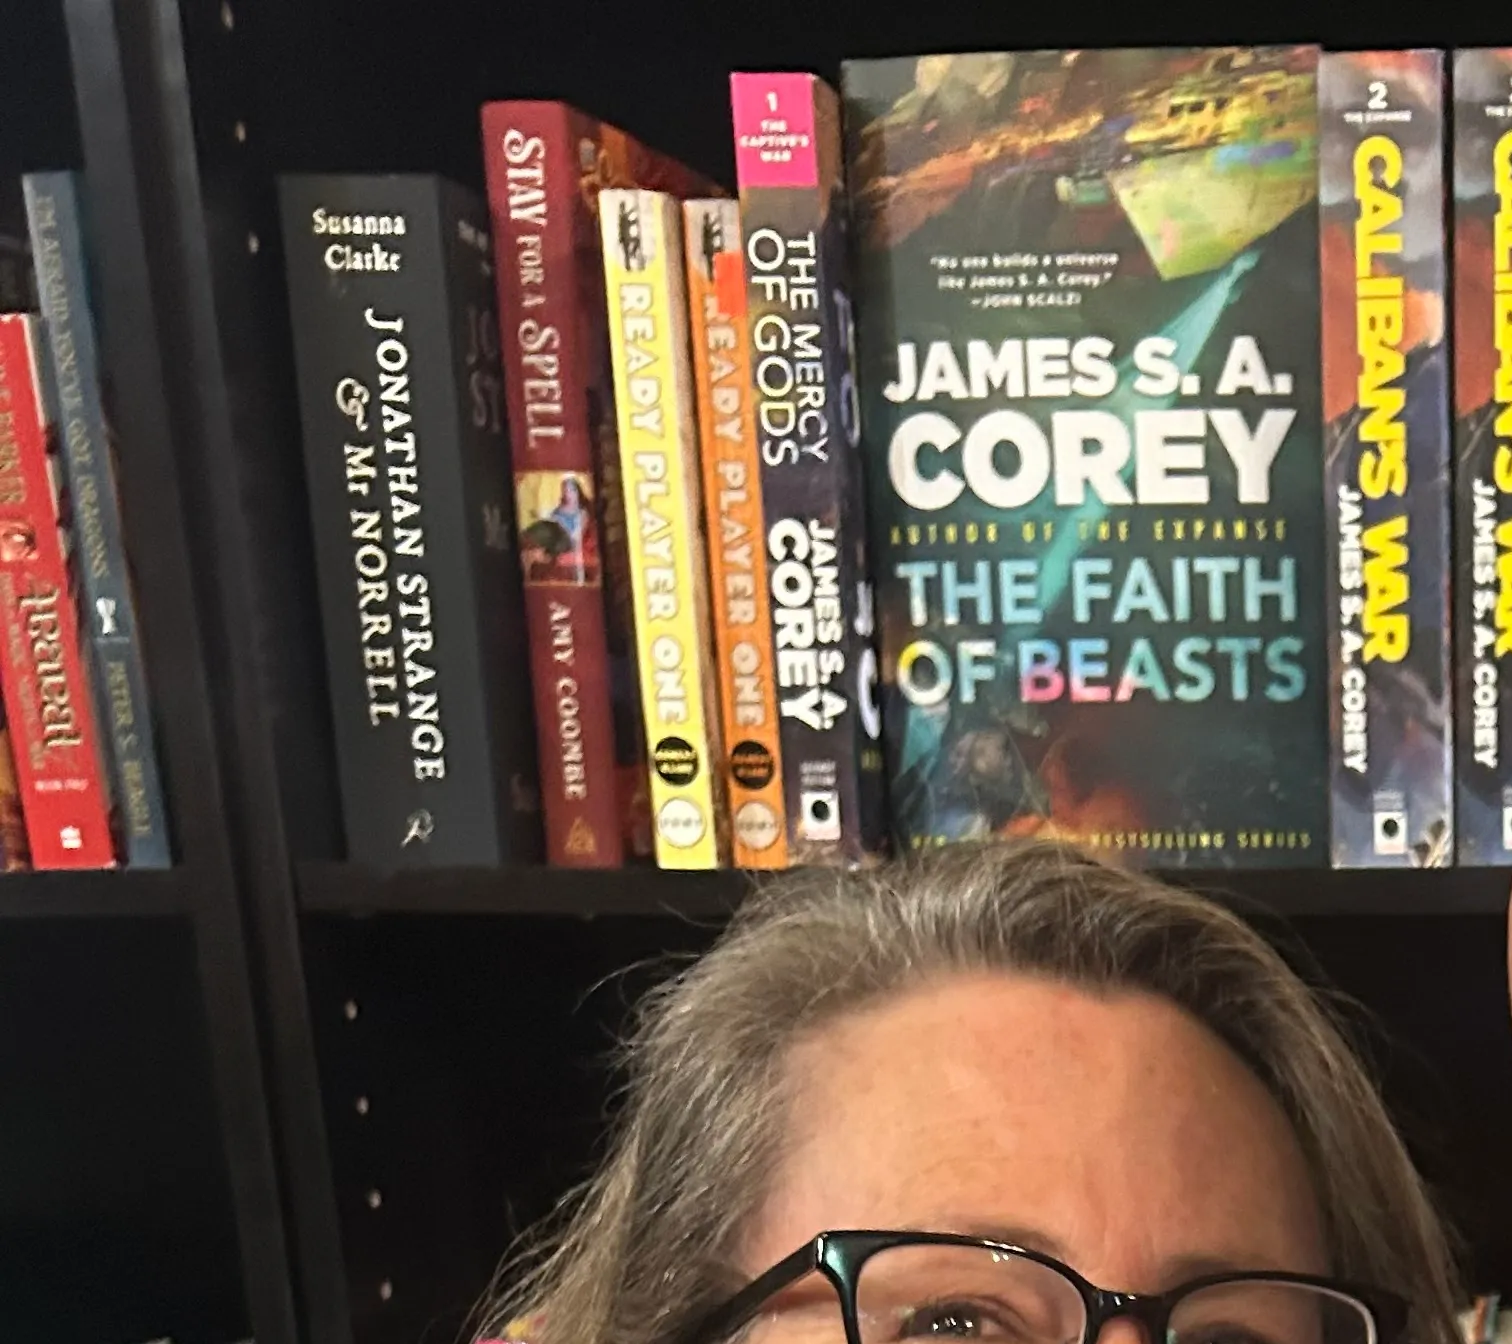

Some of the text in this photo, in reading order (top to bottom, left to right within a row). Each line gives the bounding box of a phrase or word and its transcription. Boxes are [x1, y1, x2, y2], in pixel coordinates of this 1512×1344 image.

[761, 120, 787, 133] THE
[765, 92, 778, 112] 1
[1367, 81, 1389, 109] 2
[312, 206, 406, 236] Susanna
[503, 128, 548, 227] STAY
[324, 243, 401, 272] Clarke
[516, 233, 545, 285] FOR
[969, 274, 1015, 289] James
[517, 319, 566, 448] SPELL
[619, 282, 666, 438] READY
[748, 228, 800, 468] OF GODS
[786, 230, 829, 465] THE MERCY
[882, 334, 1293, 403] JAMES S. A.
[1353, 135, 1411, 665] CALIBAN'S WAR
[344, 444, 378, 496] Mr
[887, 408, 1297, 511] COREY
[364, 307, 447, 781] JONATHAN STRANGE
[633, 451, 681, 622] PLAYER
[716, 461, 759, 625] PLAYER
[809, 517, 842, 644] JAMES
[890, 518, 1286, 546] AUTHOR OF THE EXPANSE
[1338, 483, 1363, 590] JAMES
[1472, 478, 1498, 586] JAMES
[350, 509, 400, 726] NORRELL
[549, 601, 577, 665] AMY
[768, 517, 825, 732] COREY
[896, 555, 1297, 627] THE FAITH
[650, 634, 690, 726] ONE
[730, 640, 767, 729] ONE
[898, 635, 1307, 706] OF BEASTS
[1341, 667, 1368, 774] COREY
[1473, 662, 1500, 770] COREY
